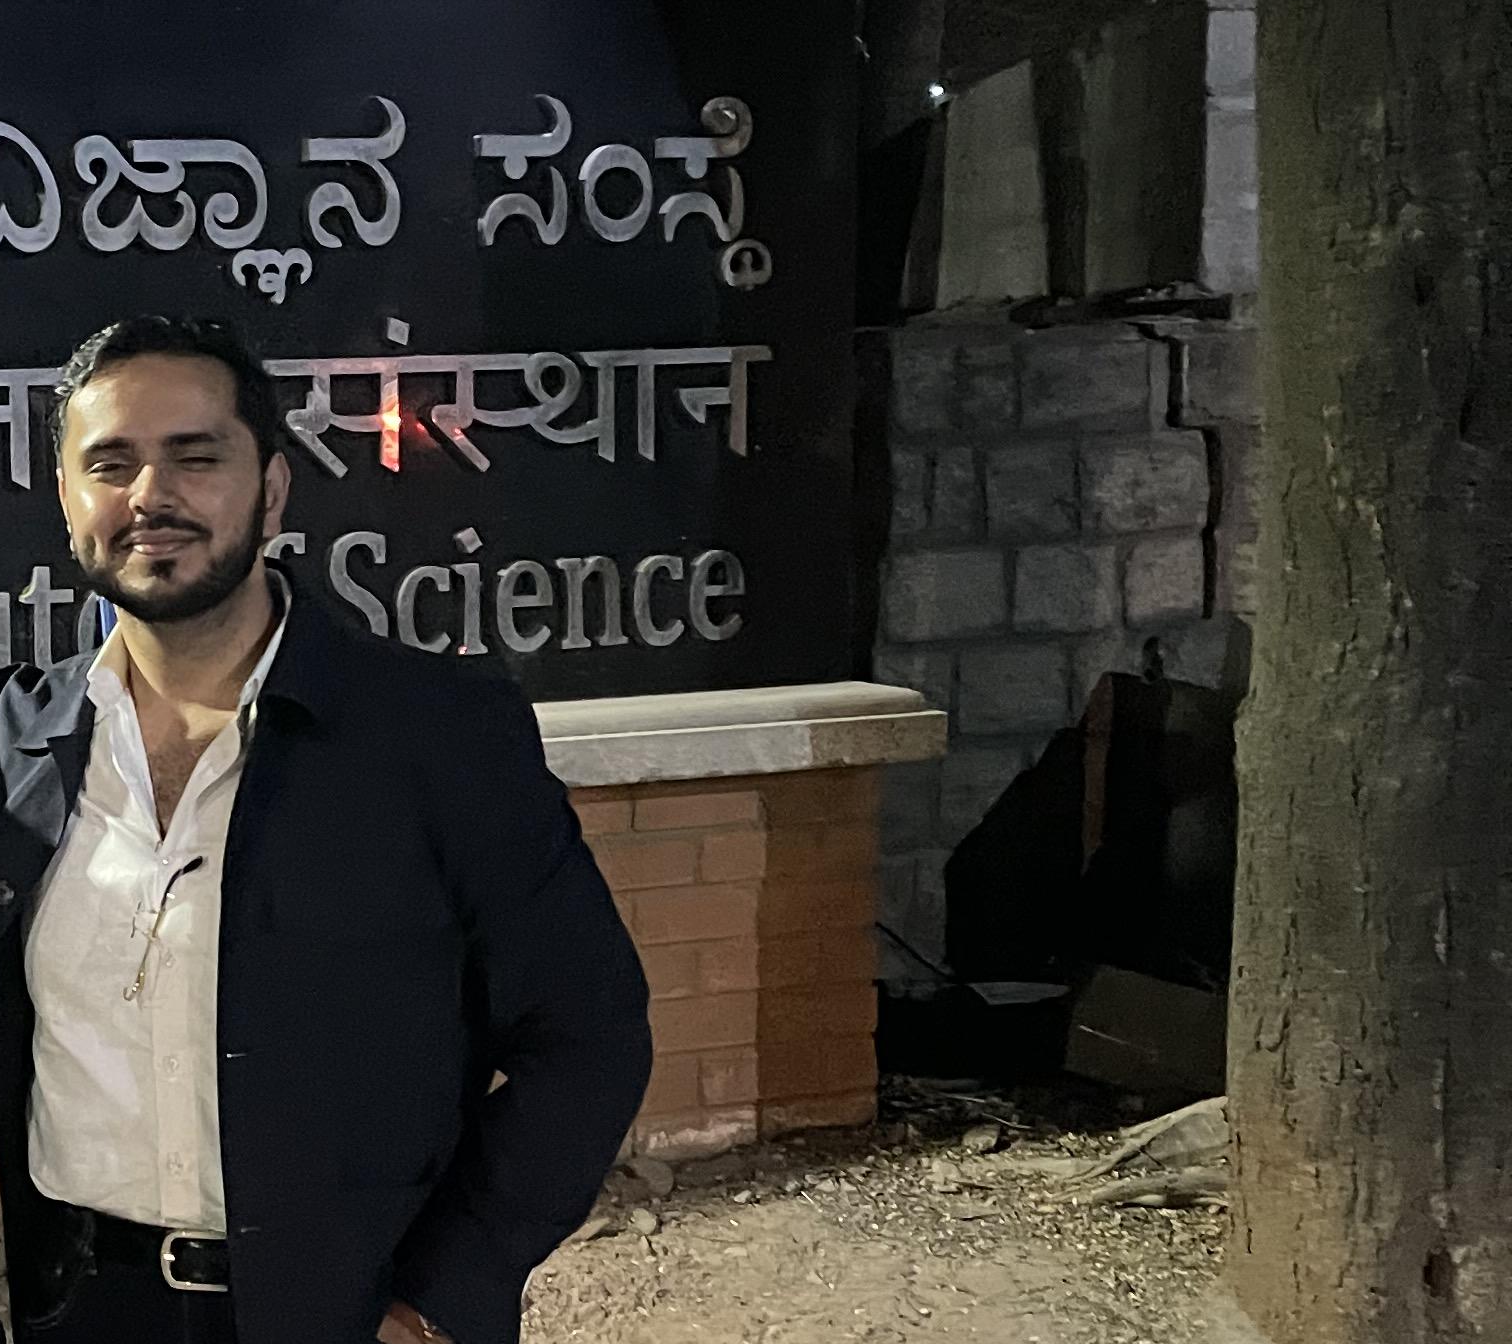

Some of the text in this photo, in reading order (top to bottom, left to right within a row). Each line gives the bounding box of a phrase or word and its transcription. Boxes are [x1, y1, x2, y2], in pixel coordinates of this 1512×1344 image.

[473, 93, 773, 291] ಸಂಸ್ಥೆ
[264, 316, 774, 478] संस्थान
[329, 527, 746, 656] Science
